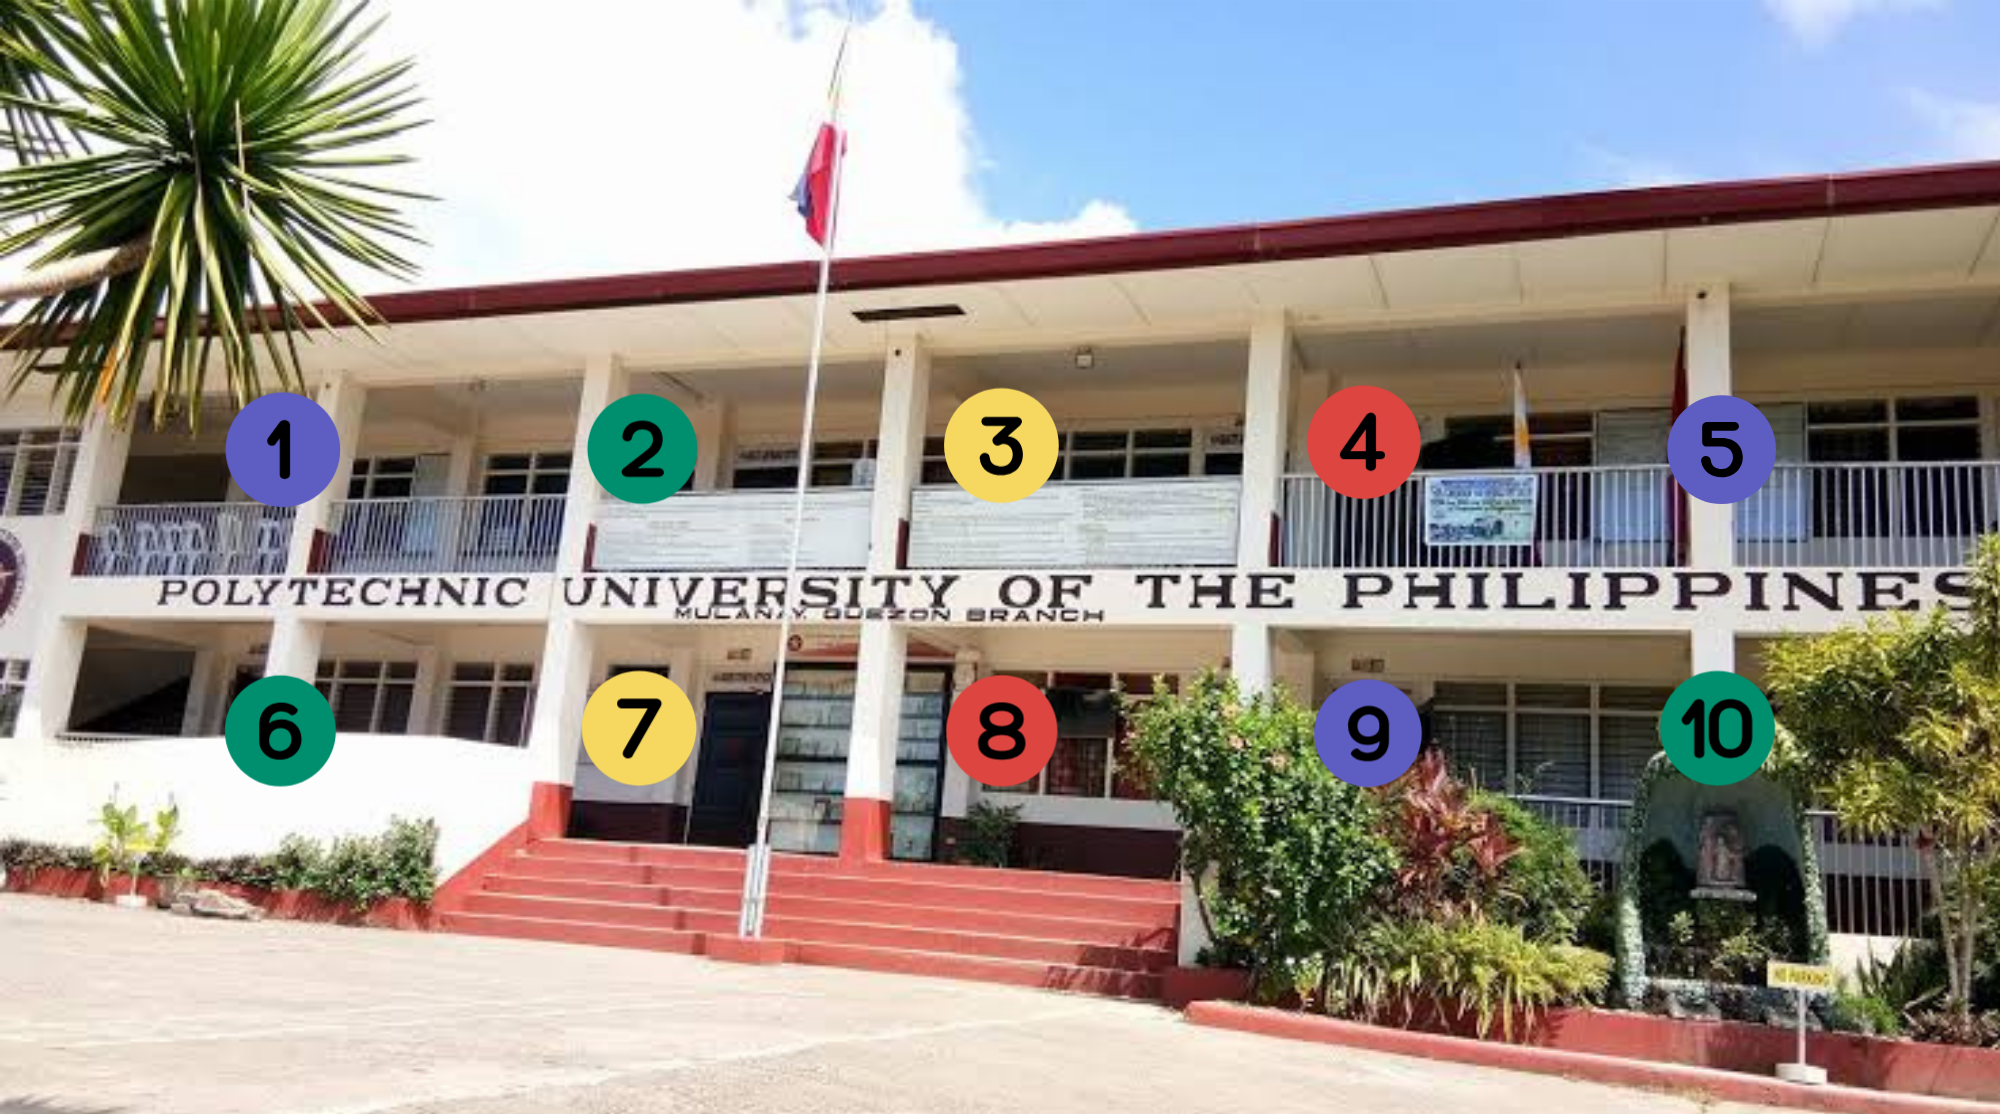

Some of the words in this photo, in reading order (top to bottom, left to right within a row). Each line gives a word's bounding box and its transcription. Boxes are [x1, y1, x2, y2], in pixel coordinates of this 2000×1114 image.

[157, 577, 530, 607] POLYTECHNIC
[562, 576, 960, 608] UNIVERSITY
[998, 574, 1093, 608] OF
[1135, 574, 1296, 609] THE
[1341, 572, 1978, 611] PHILIPPINES
[824, 608, 951, 621] QUEZON
[966, 609, 1104, 622] BRANCH
